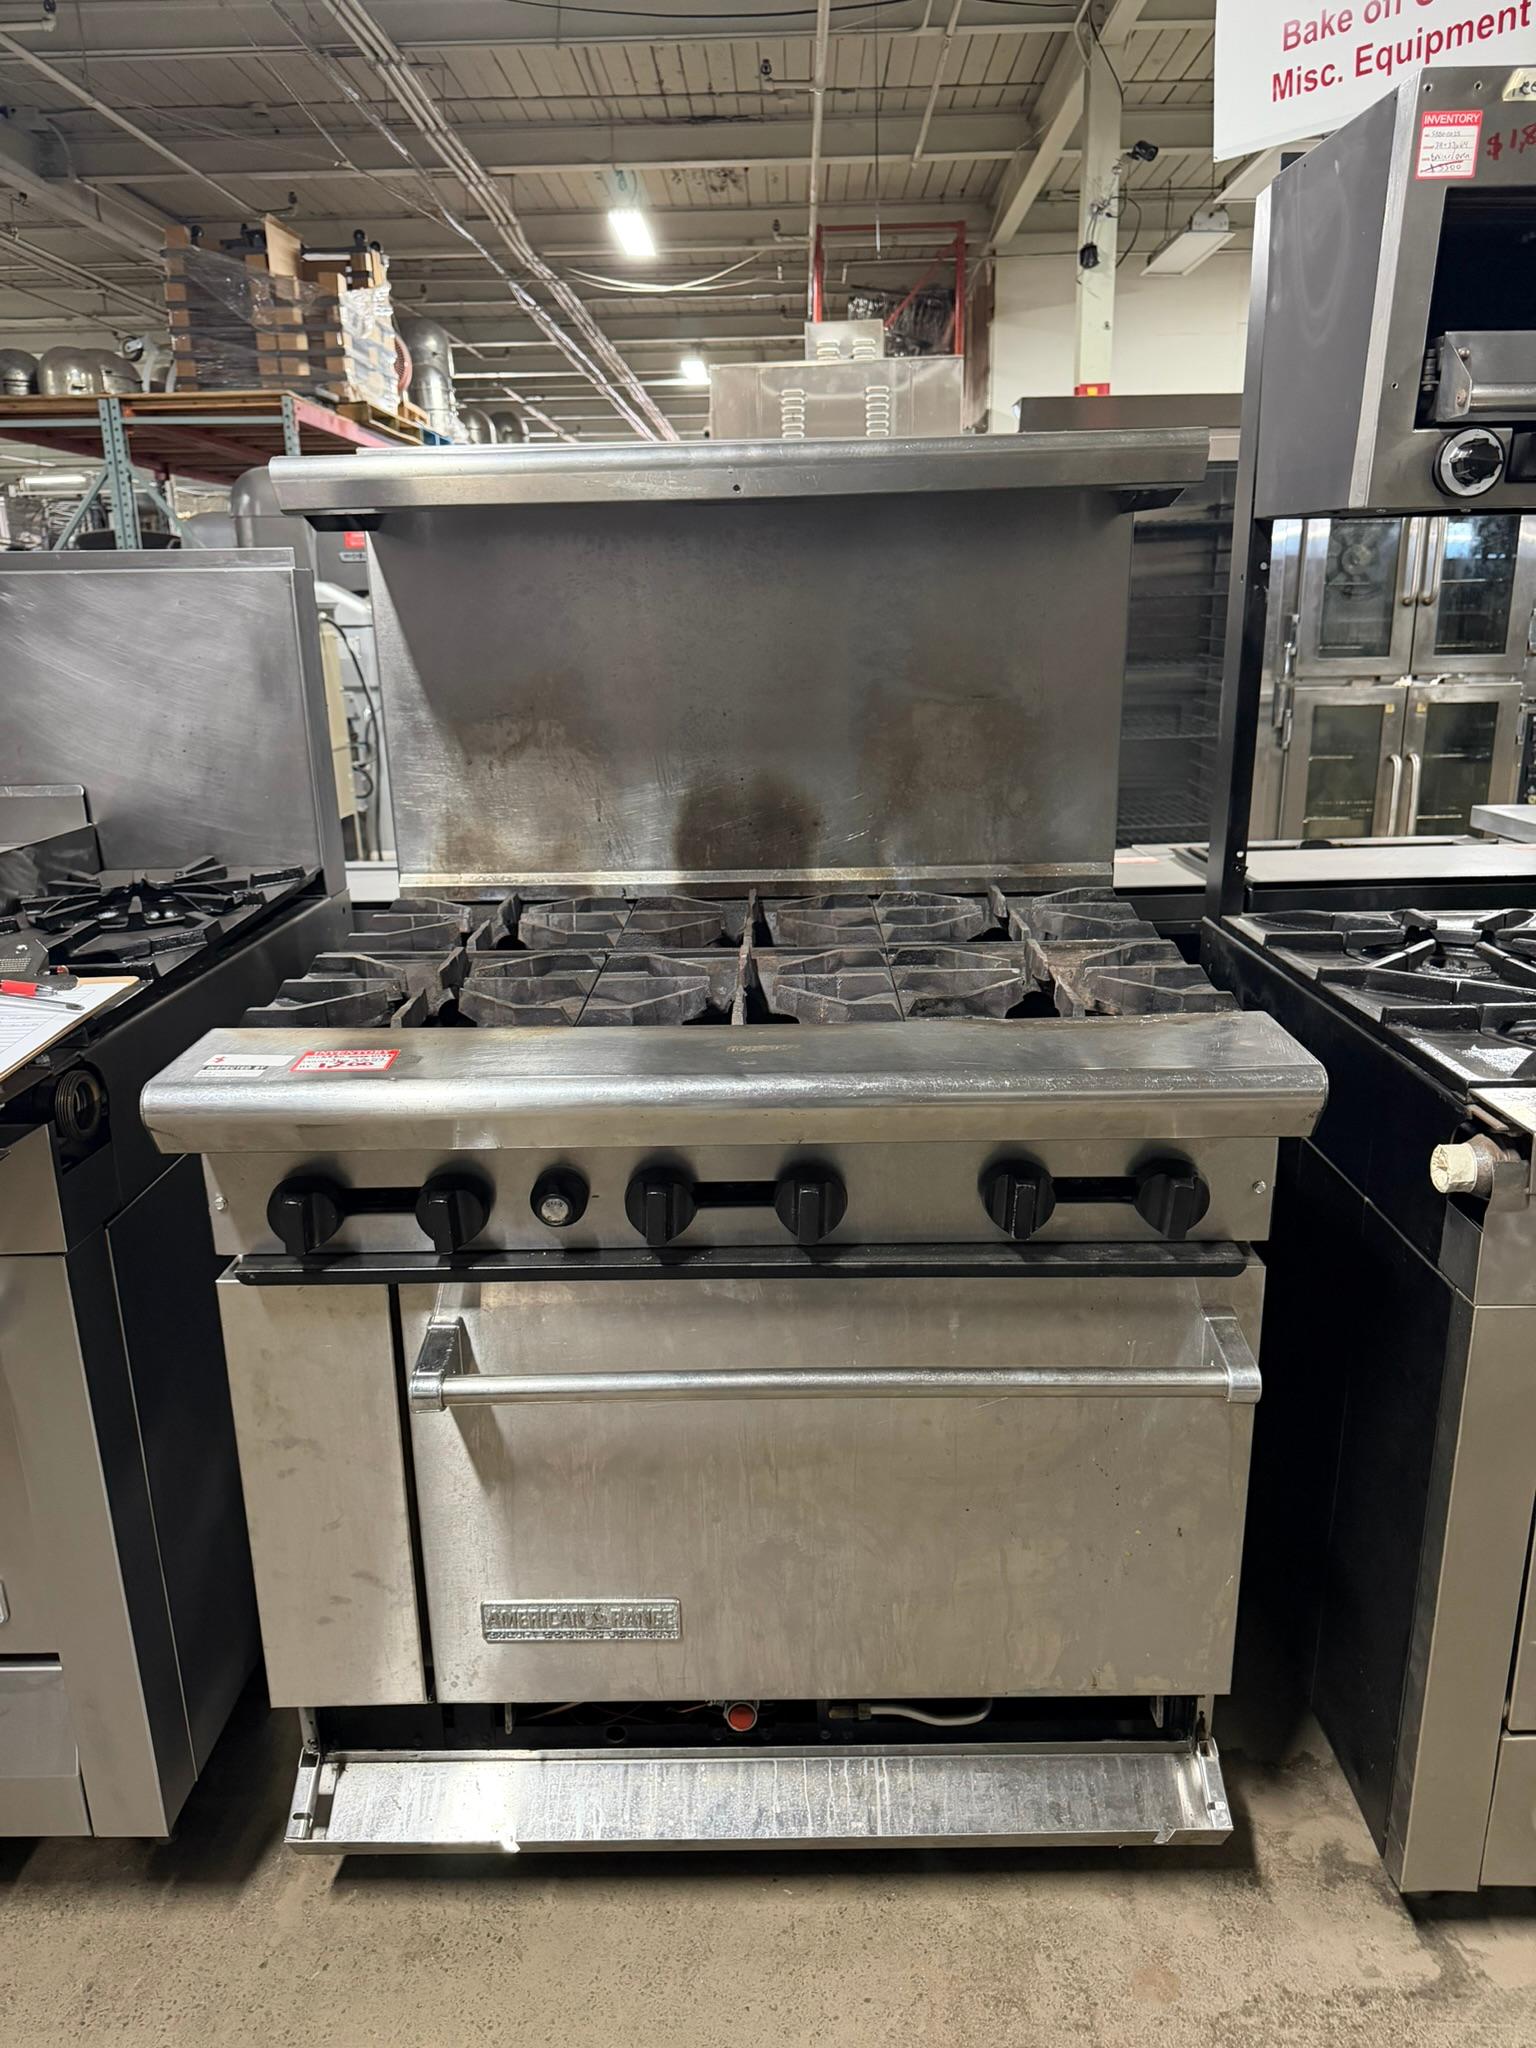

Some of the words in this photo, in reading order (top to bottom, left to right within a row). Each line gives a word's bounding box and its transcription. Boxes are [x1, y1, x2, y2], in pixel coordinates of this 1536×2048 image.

[1282, 9, 1353, 52] Bake
[1271, 65, 1344, 103] Misc.
[1355, 0, 1531, 77] Equipment
[1424, 113, 1481, 125] INVENTORY
[486, 1608, 586, 1628] AMERICAN
[610, 1608, 675, 1628] RANGE
